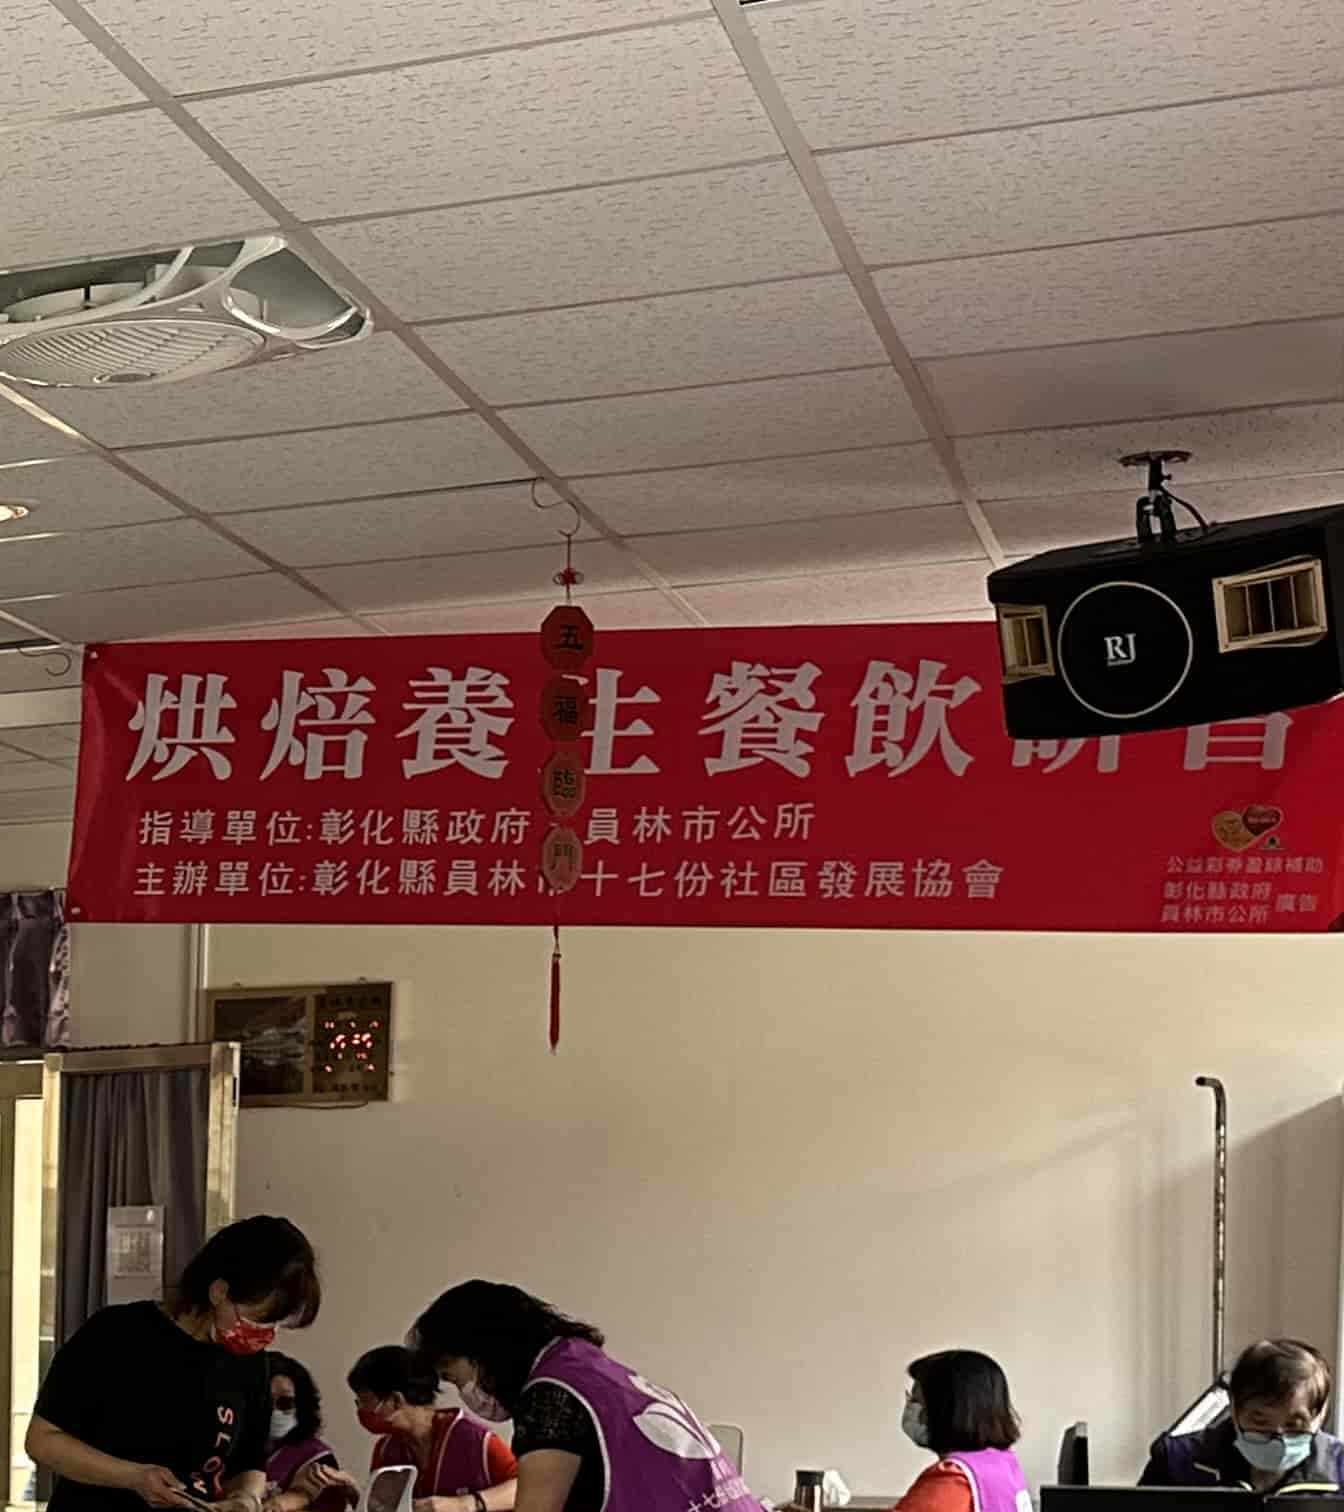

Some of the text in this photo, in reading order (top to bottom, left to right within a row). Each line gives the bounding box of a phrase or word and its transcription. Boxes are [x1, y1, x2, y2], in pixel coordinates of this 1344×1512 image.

[1103, 632, 1138, 667] RJ
[138, 802, 815, 846] 指導單位:彰化縣政府員林市公所
